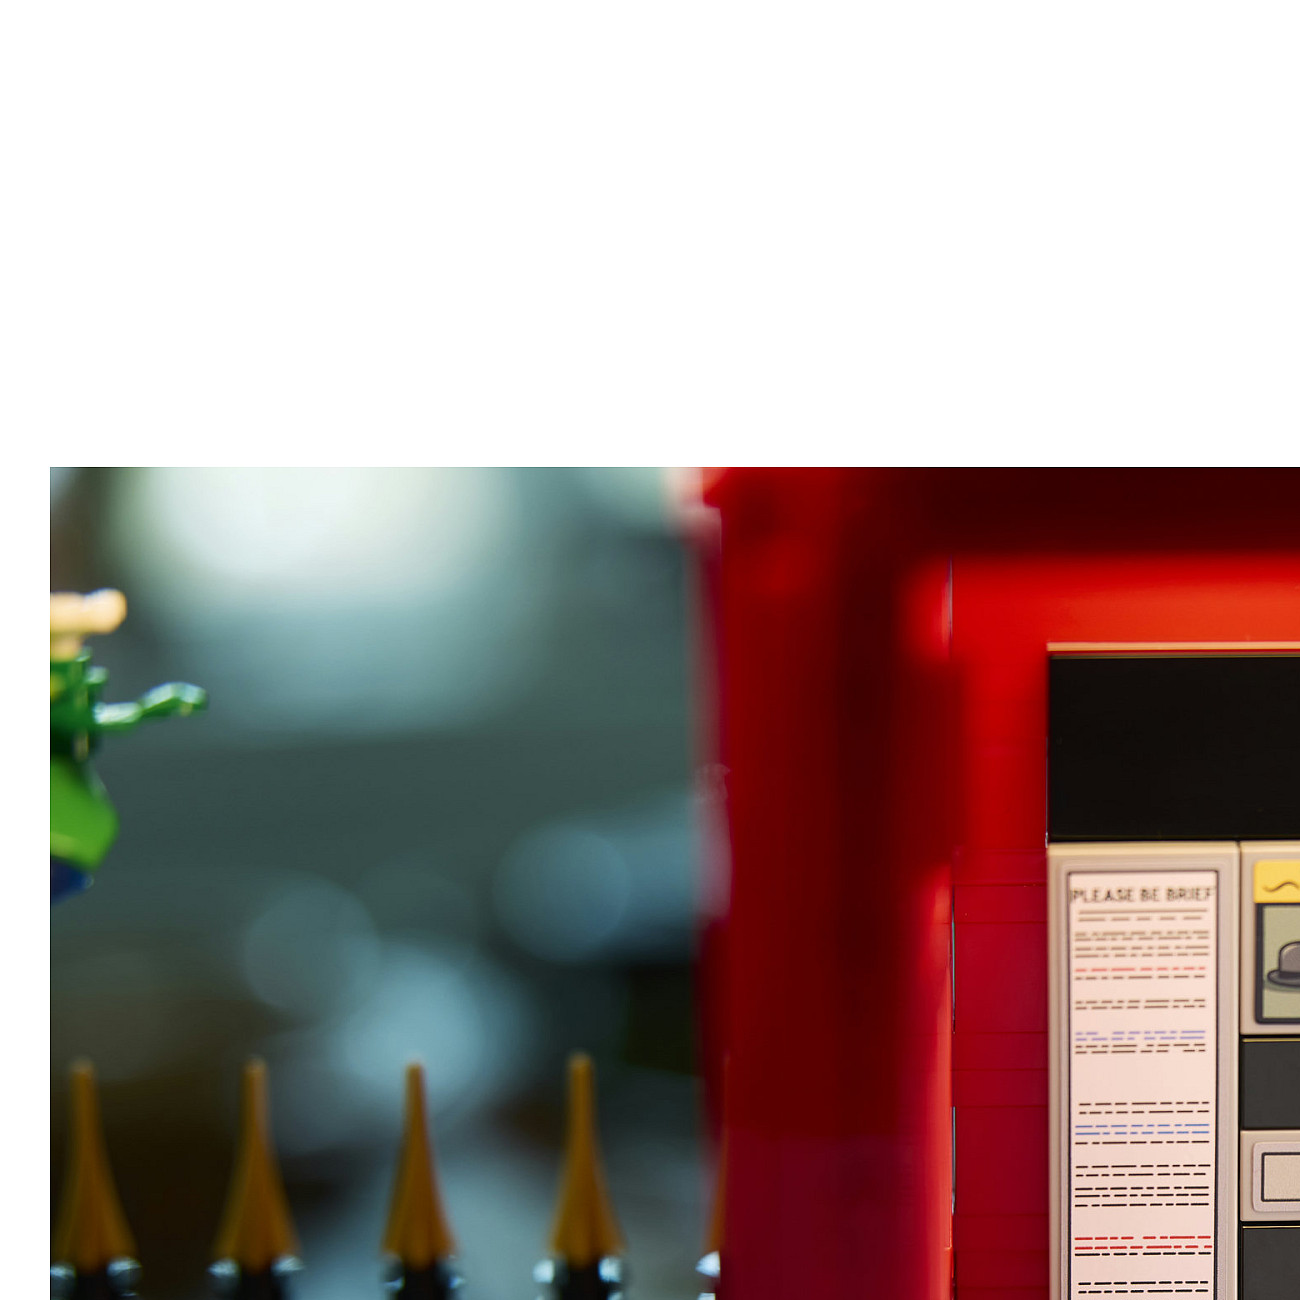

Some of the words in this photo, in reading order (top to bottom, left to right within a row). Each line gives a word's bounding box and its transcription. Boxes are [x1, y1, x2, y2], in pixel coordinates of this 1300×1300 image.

[1071, 886, 1135, 903] PLEASE
[1140, 886, 1160, 902] BE
[1166, 886, 1216, 902] BRIEF
